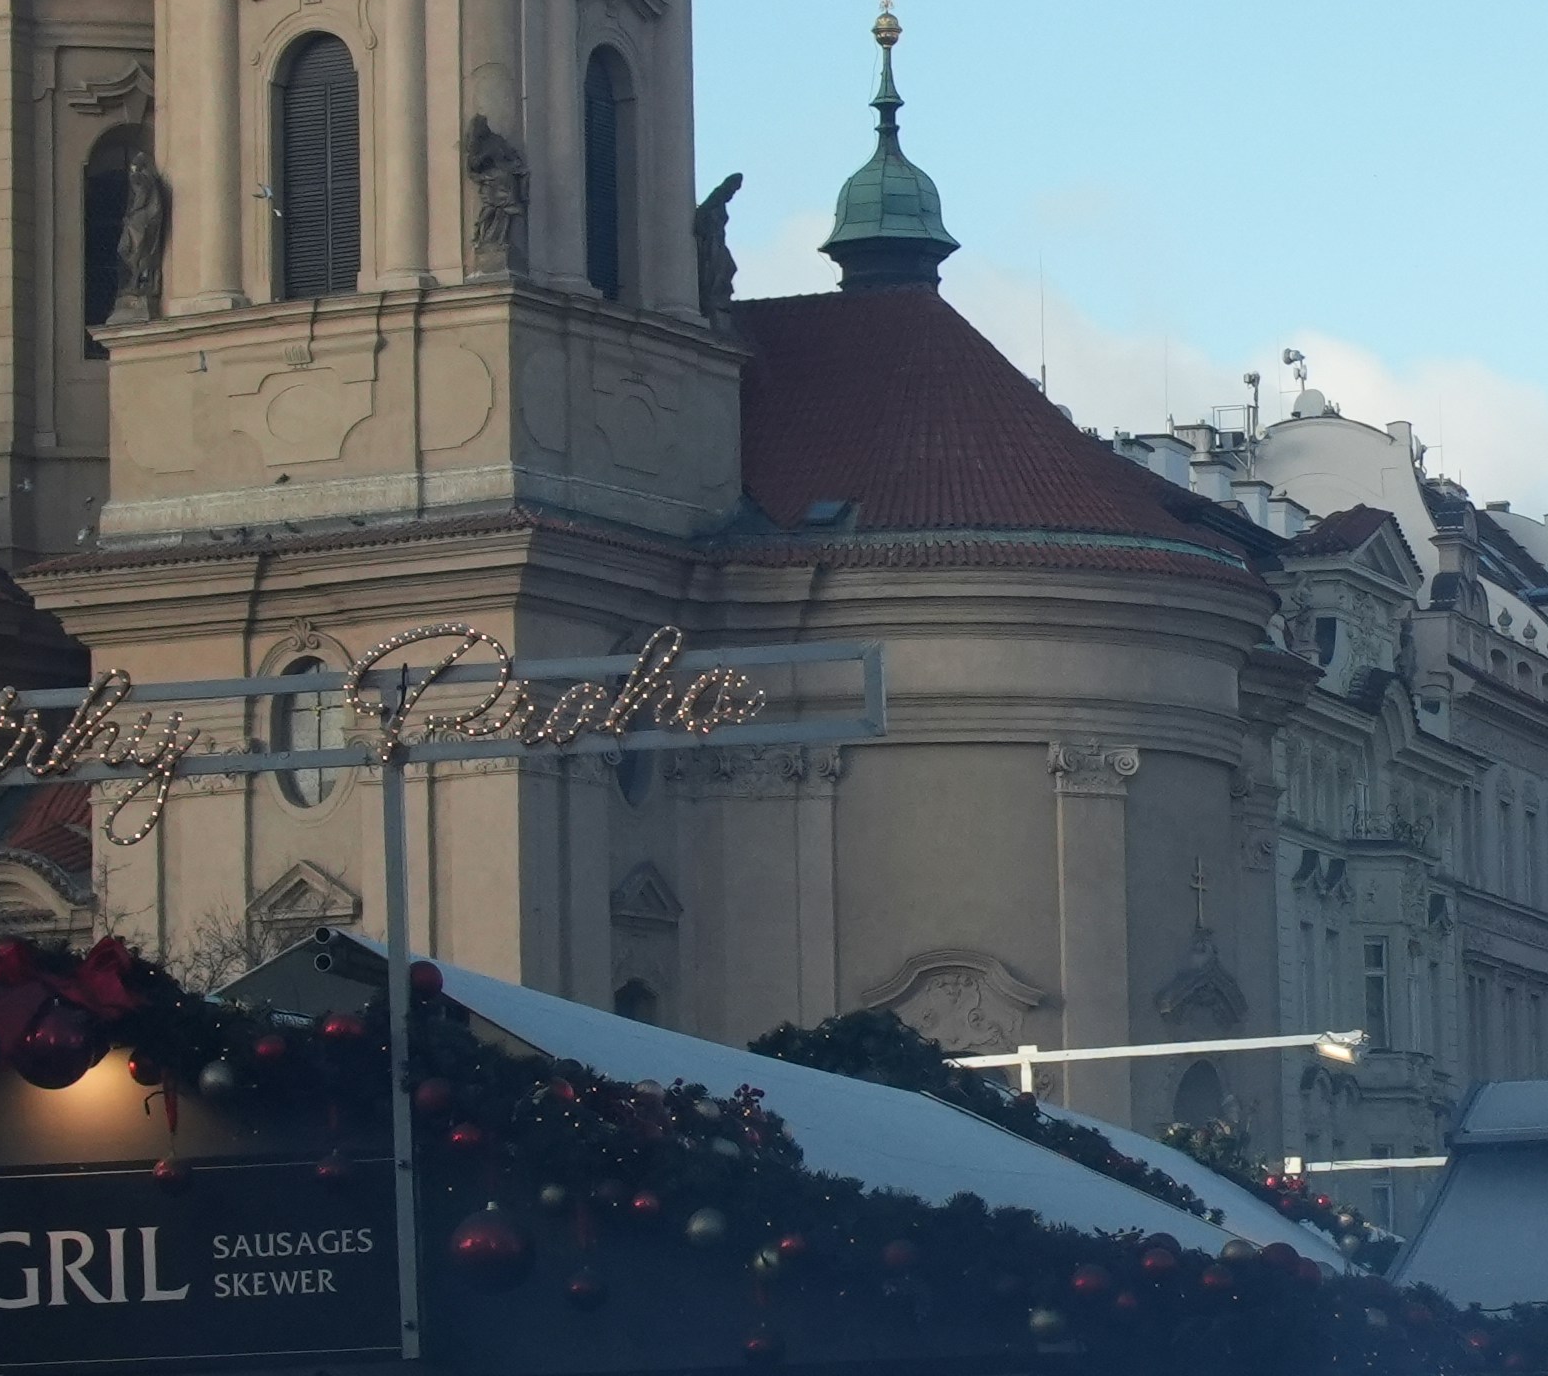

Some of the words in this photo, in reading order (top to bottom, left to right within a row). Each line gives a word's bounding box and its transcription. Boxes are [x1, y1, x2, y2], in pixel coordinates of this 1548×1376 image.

[344, 622, 767, 762] Praha
[212, 1227, 374, 1260] SAUSAGES
[213, 1268, 338, 1298] SKEWER
